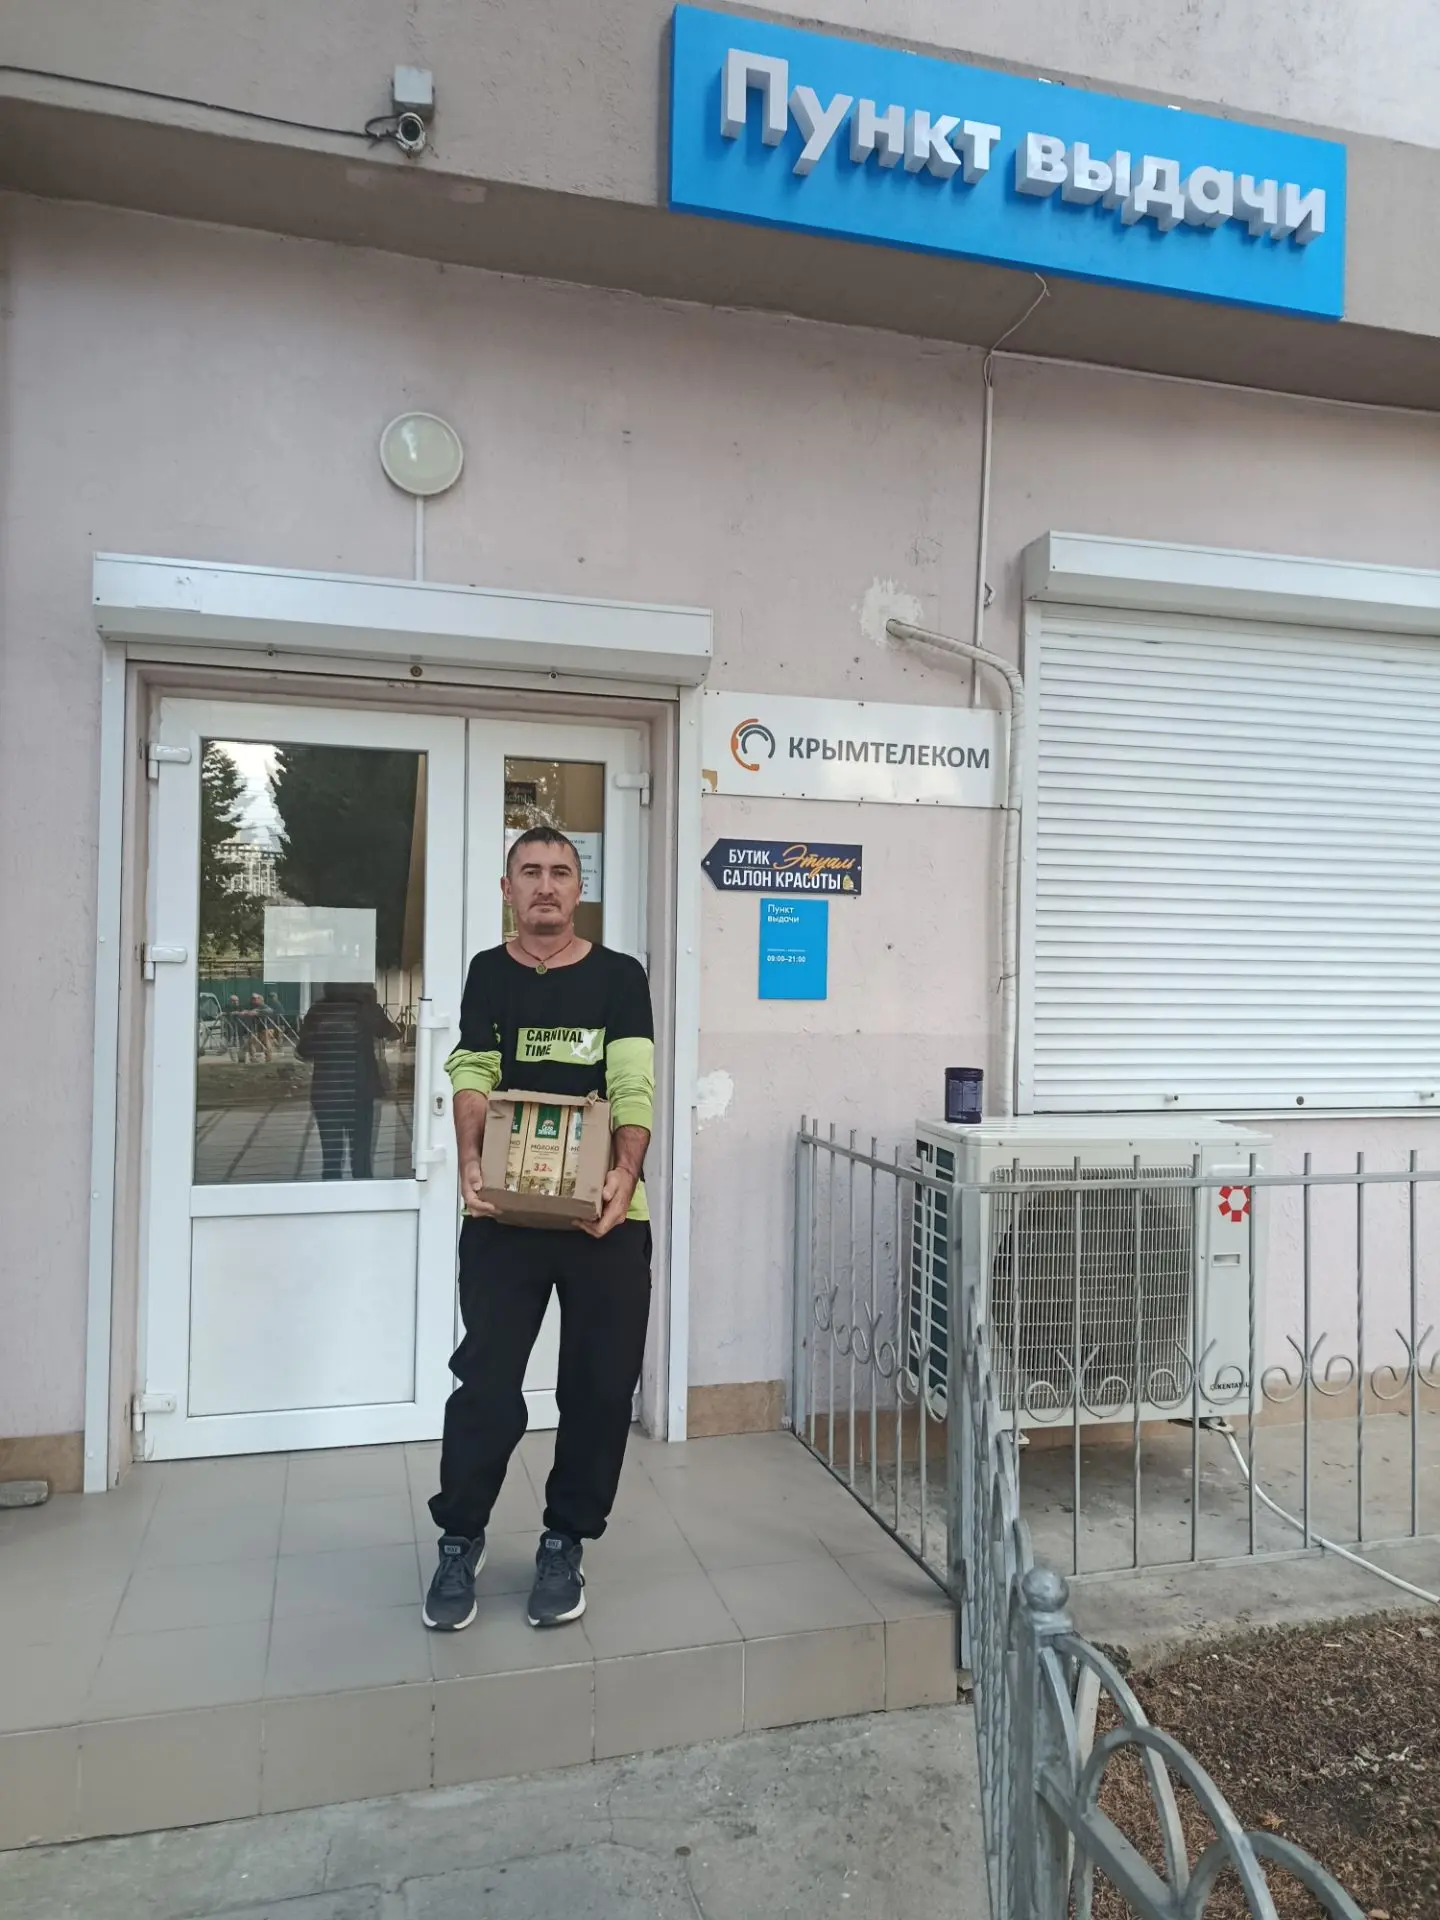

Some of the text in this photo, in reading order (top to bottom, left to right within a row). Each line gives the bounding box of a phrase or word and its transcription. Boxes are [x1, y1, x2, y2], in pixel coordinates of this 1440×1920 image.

[721, 48, 1326, 245] Пункт выдачи
[788, 736, 990, 770] КРЫМТЕЛЕКОМ
[729, 849, 770, 865] БУТИК
[723, 869, 841, 889] САЛОН КРАСОТЫ
[767, 903, 796, 915] Пункт
[767, 915, 800, 924] выдачи
[526, 1029, 584, 1044] CARNIVAL
[525, 1043, 552, 1057] TIME
[530, 1144, 560, 1152] МОЛОКО
